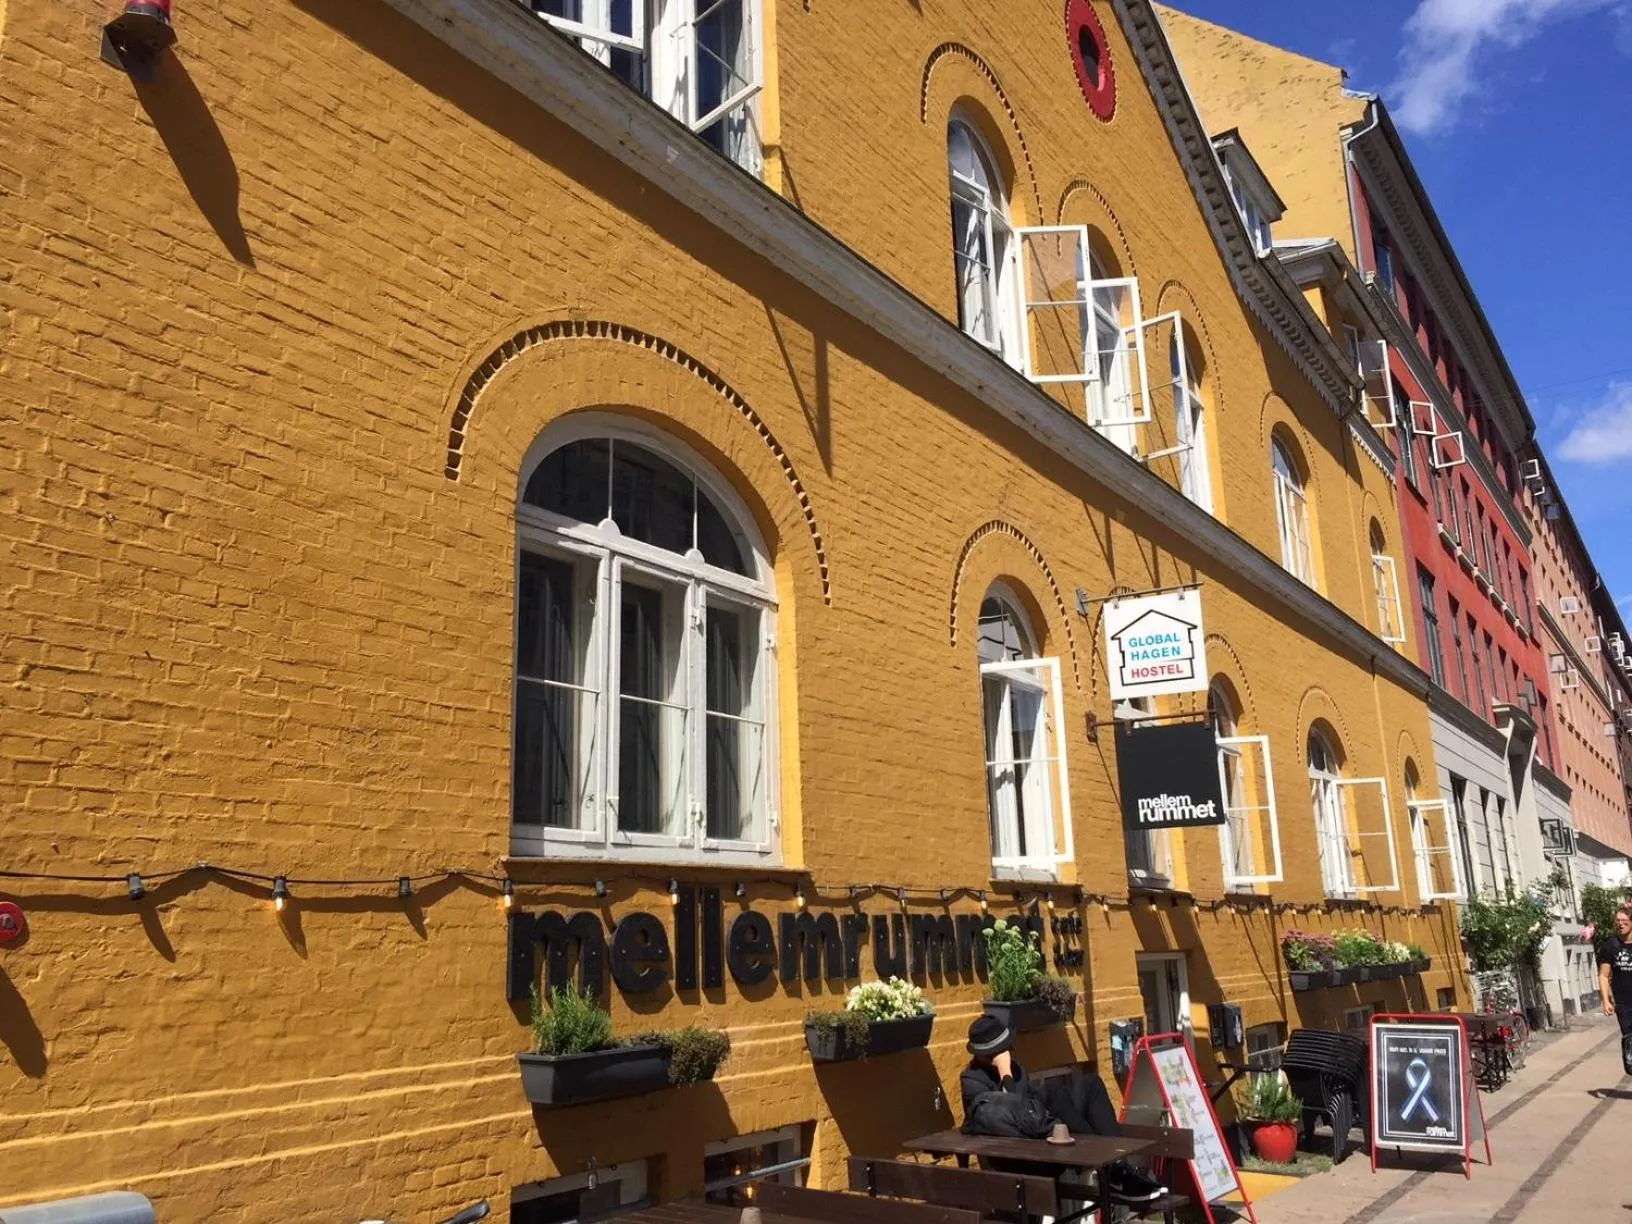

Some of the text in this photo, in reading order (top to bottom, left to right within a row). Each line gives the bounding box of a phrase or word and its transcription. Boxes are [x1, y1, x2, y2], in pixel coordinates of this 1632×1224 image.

[1128, 631, 1181, 648] GLOBAL
[1130, 645, 1181, 661] HAGEN
[1131, 663, 1184, 679] HOSTEL
[1138, 793, 1191, 810] mellem
[1139, 799, 1216, 822] rummet
